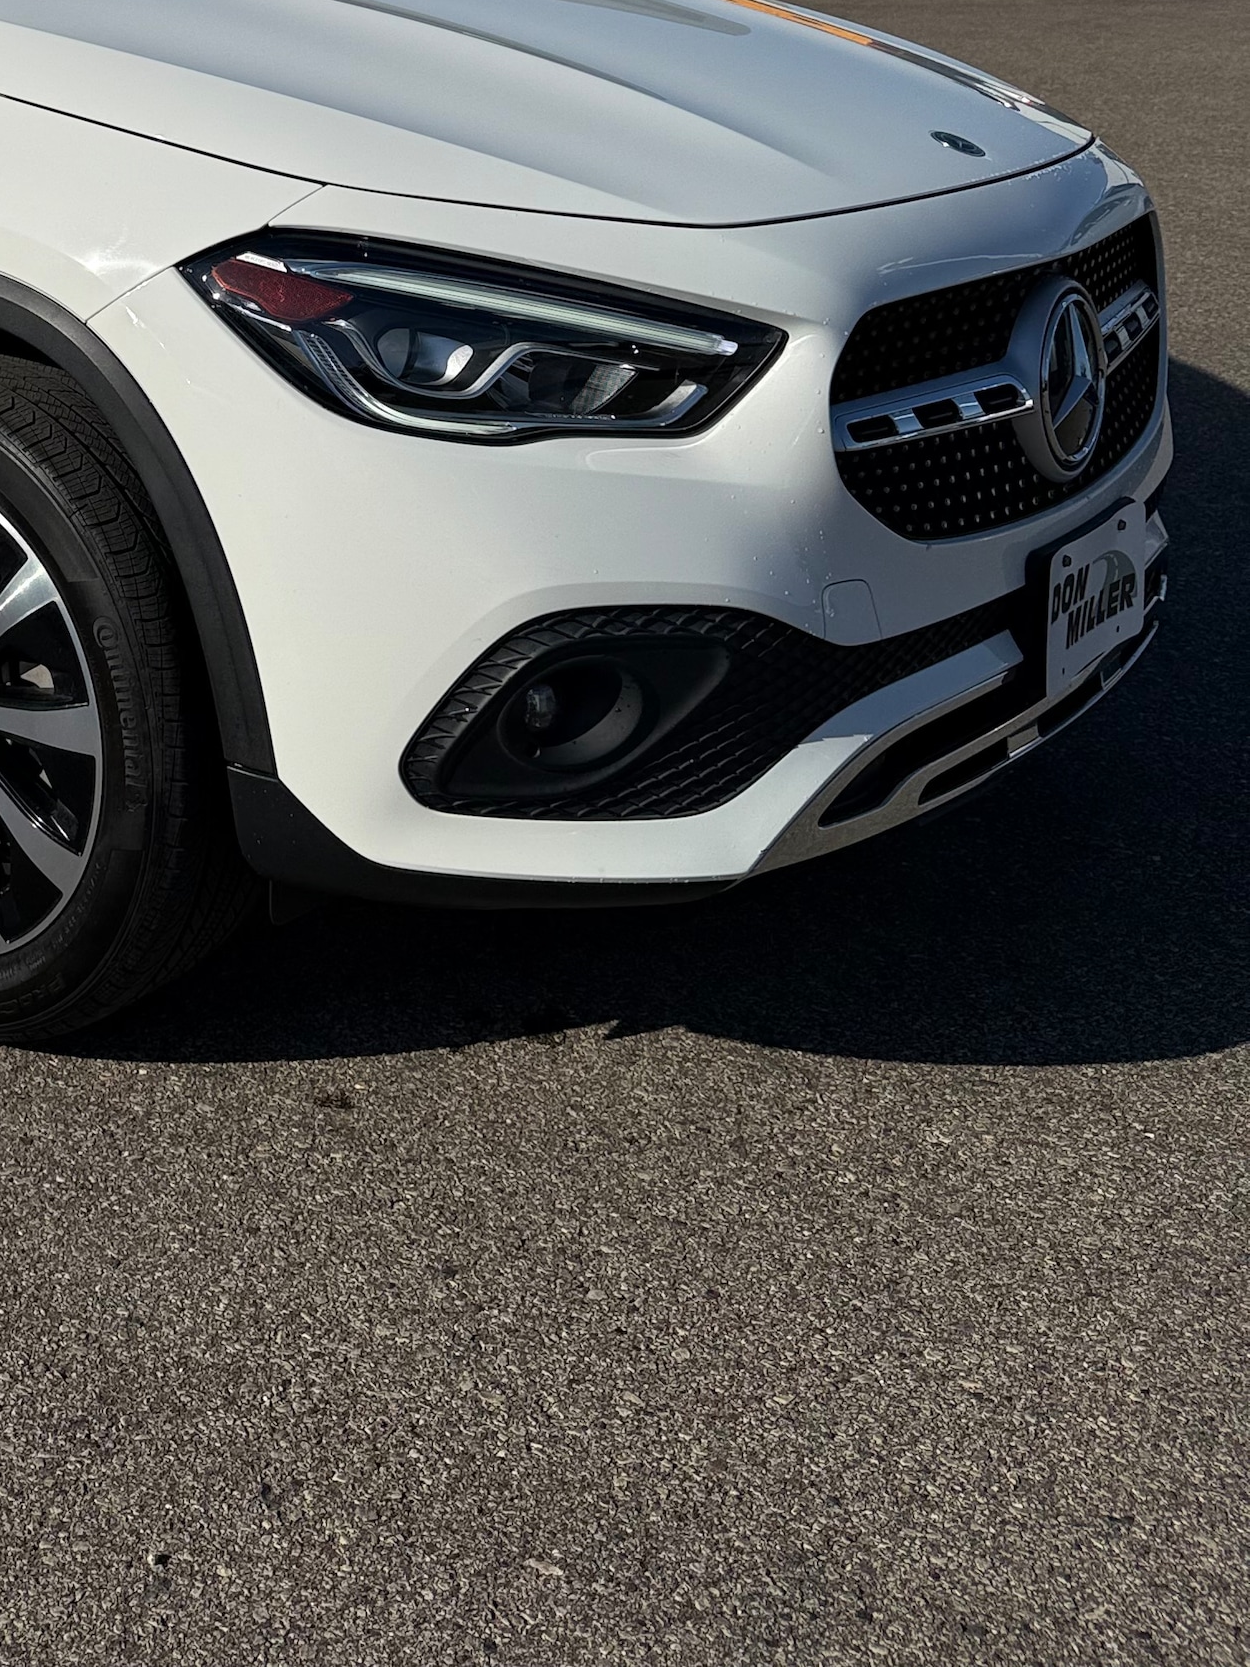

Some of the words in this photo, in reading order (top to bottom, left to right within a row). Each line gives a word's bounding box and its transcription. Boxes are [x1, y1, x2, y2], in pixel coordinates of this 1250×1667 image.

[1051, 563, 1090, 625] DON
[1066, 573, 1136, 650] MILLER
[92, 615, 147, 789] Continental
